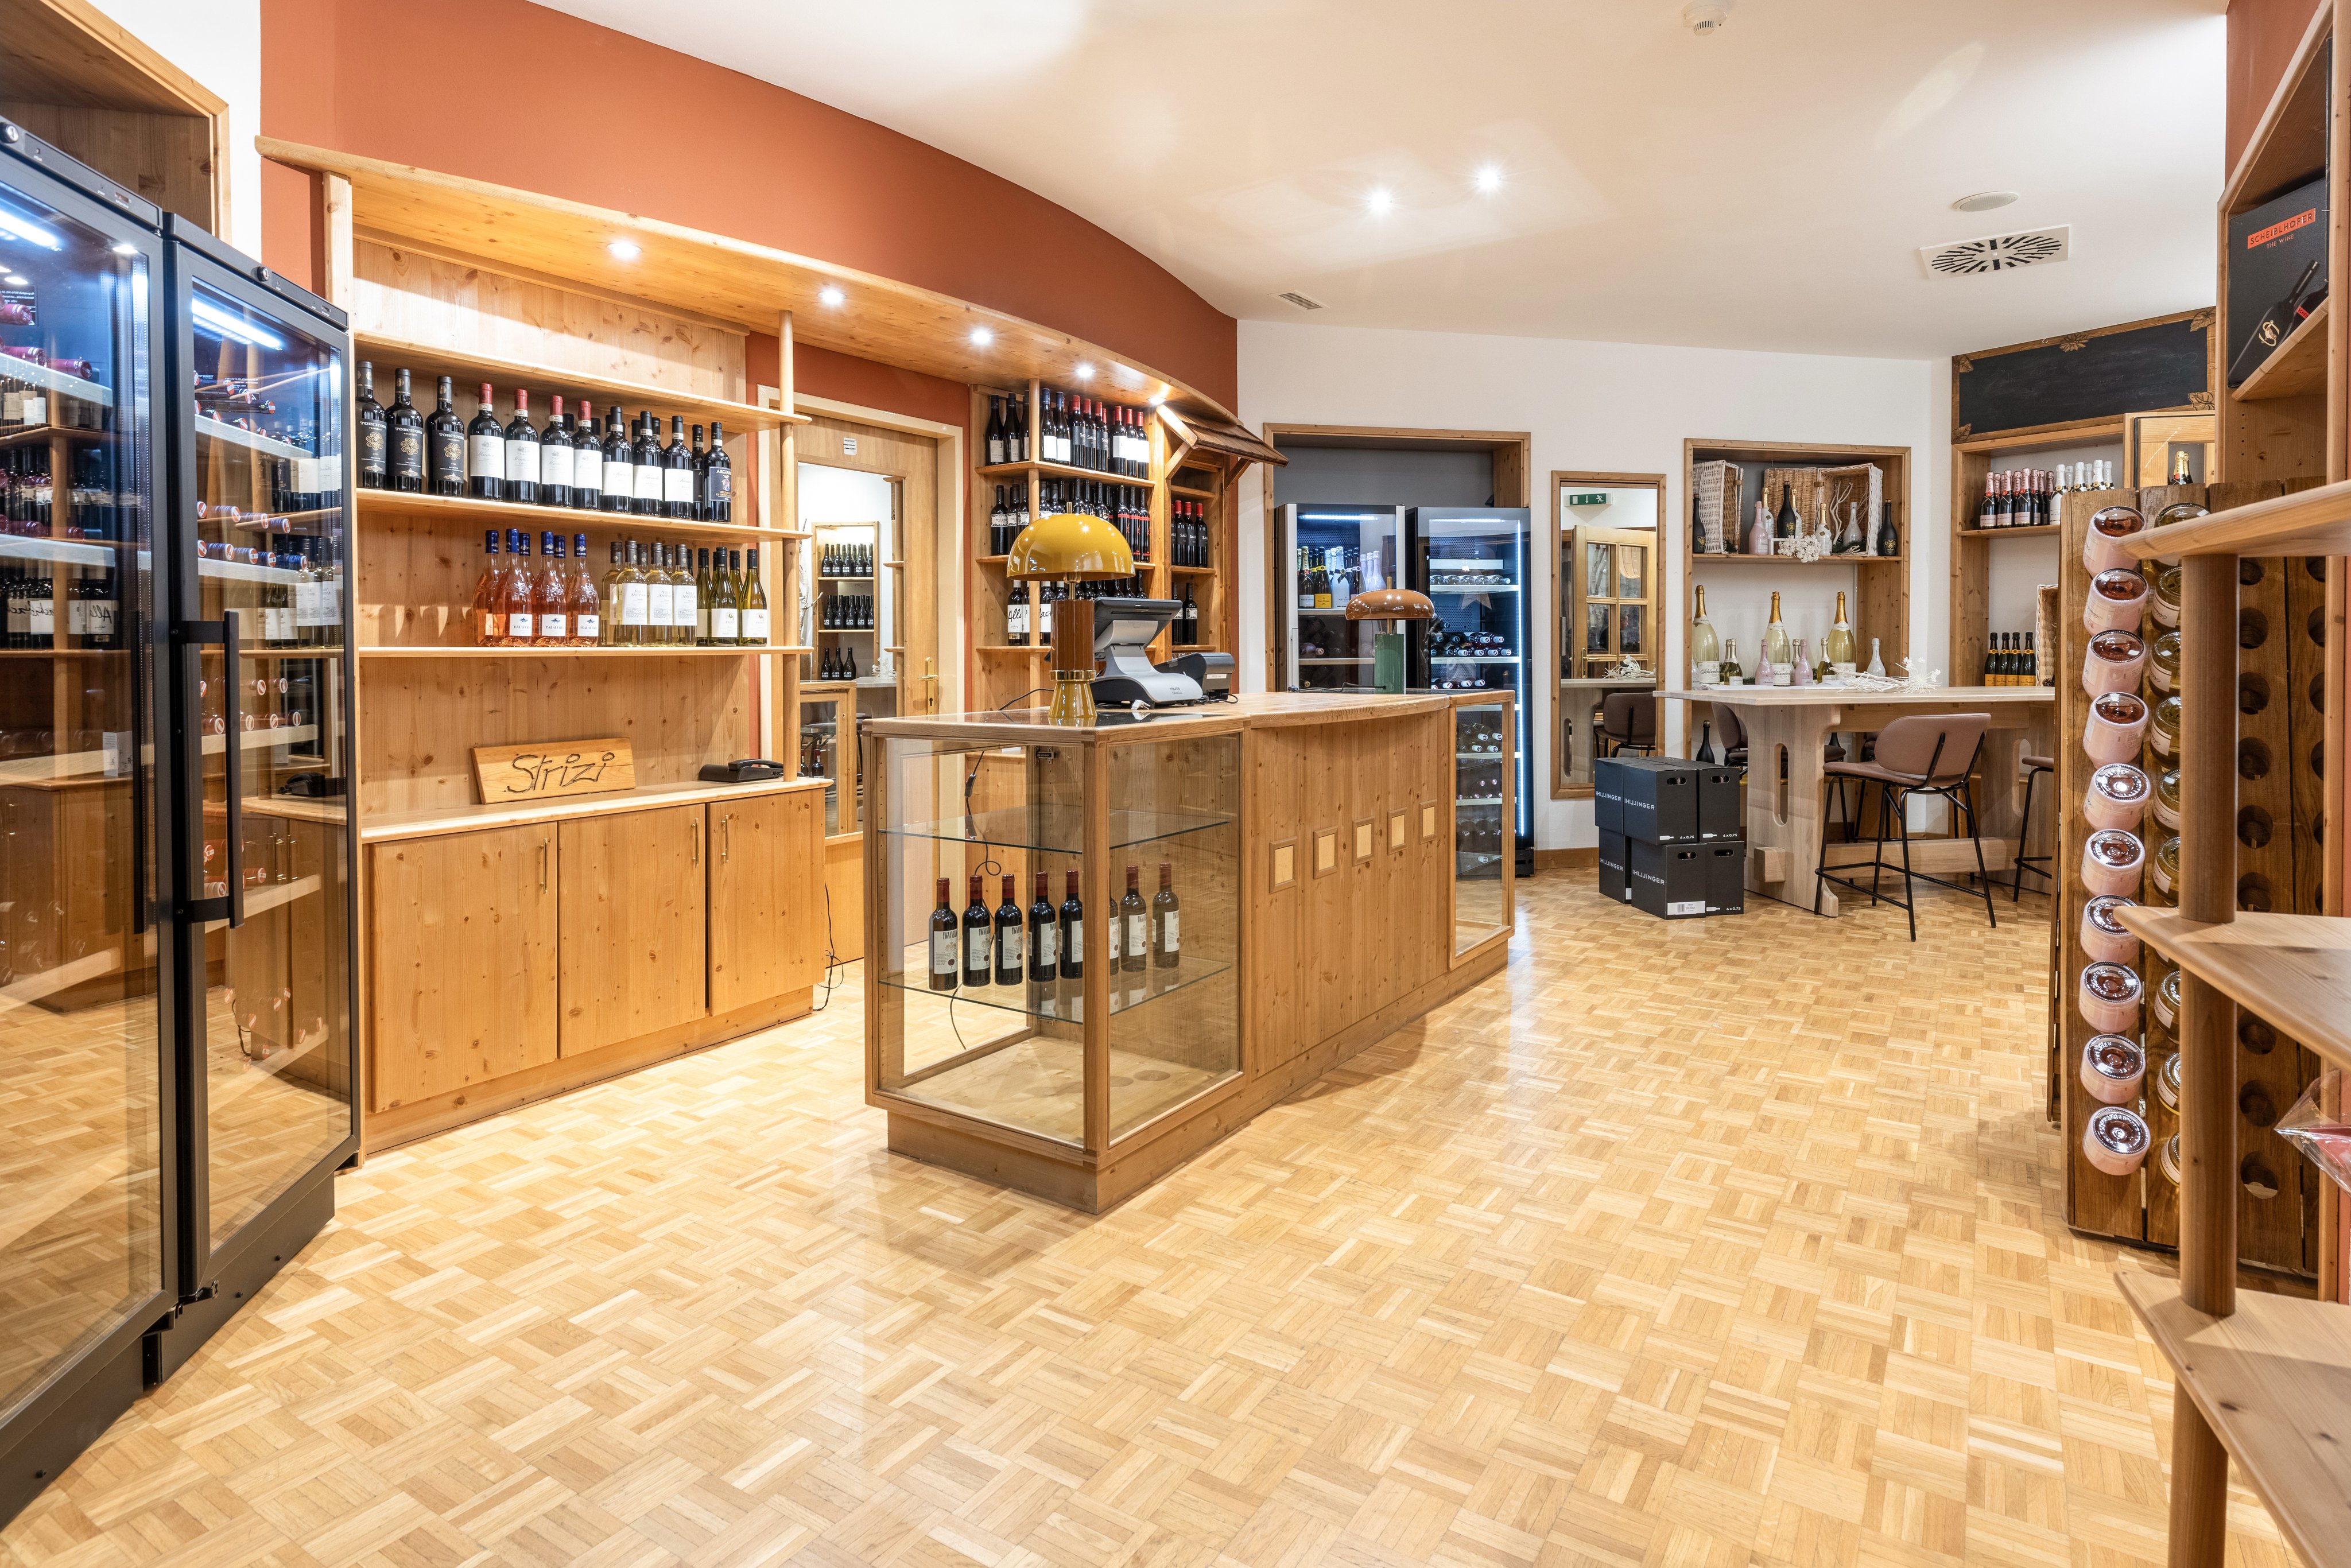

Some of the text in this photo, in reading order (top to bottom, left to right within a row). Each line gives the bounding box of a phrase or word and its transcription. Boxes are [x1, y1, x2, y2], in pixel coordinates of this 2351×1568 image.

[2251, 213, 2313, 244] SCHEIBLHOFER
[2267, 234, 2294, 249] THE WINE
[2298, 308, 2309, 319] SCHEI
